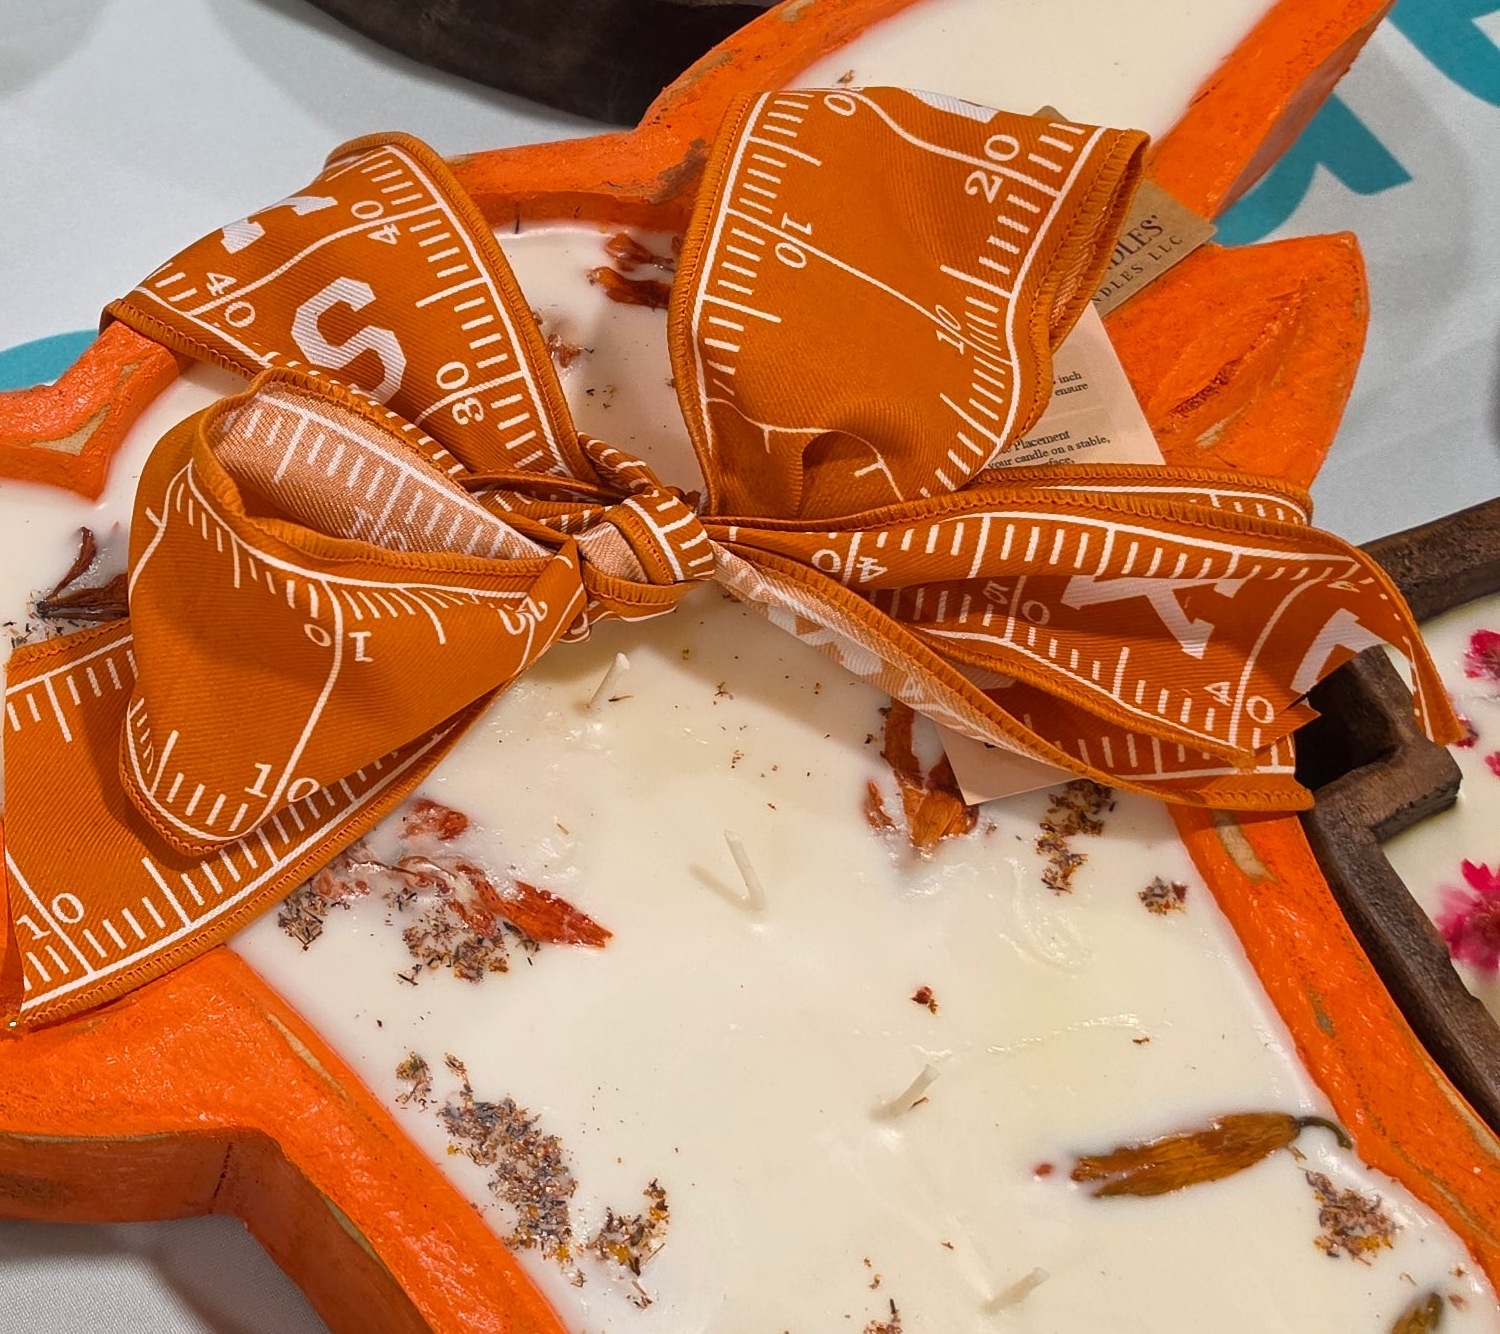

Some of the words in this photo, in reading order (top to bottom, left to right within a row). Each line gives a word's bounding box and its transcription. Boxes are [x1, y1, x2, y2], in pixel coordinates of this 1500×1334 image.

[1152, 234, 1184, 261] LLC
[1054, 381, 1089, 397] ensure
[1058, 370, 1083, 386] inch
[1013, 430, 1071, 454] Placement
[1015, 448, 1050, 464] candle
[1051, 444, 1067, 457] on
[1067, 442, 1075, 451] a
[1076, 434, 1112, 452] stable,
